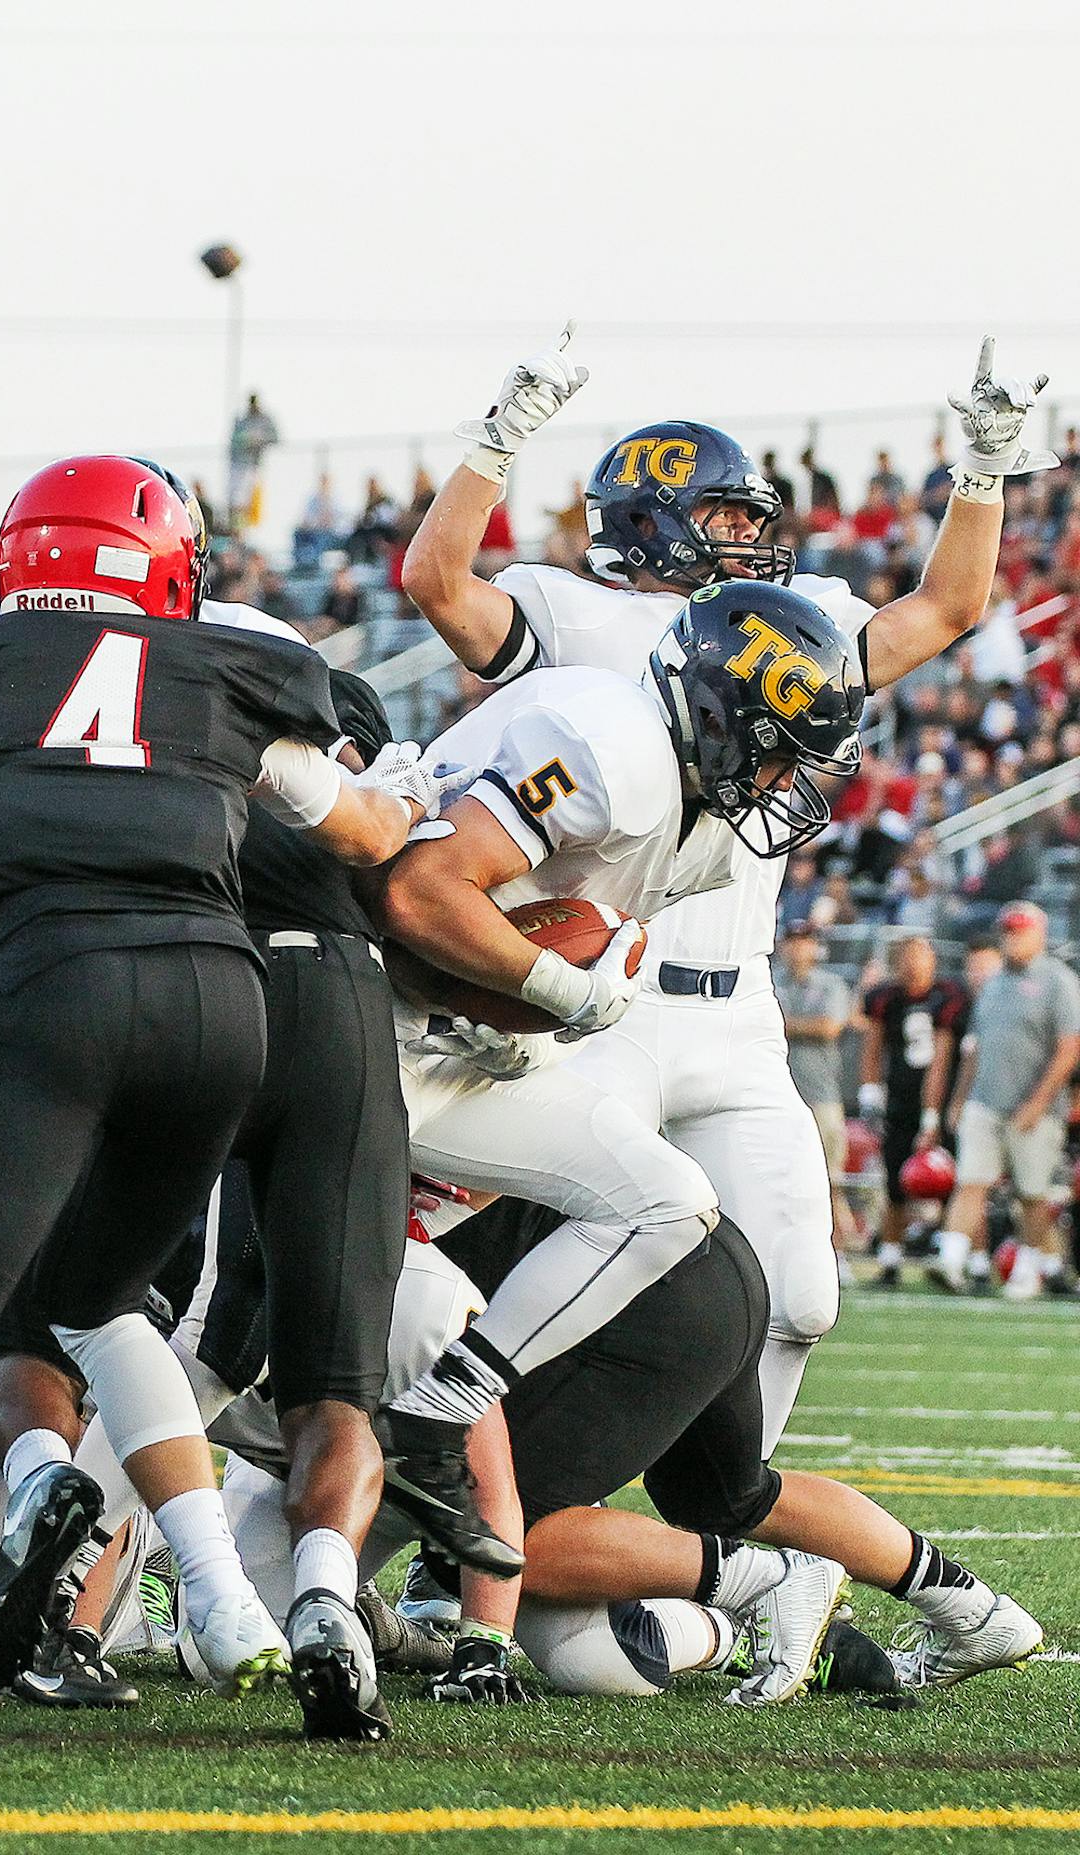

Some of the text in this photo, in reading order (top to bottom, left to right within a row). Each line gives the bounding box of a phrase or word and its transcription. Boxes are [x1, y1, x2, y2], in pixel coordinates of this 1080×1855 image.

[614, 437, 698, 488] TG
[16, 593, 95, 612] Riddell
[723, 613, 828, 720] TG
[37, 628, 152, 768] 4
[516, 757, 579, 817] 5
